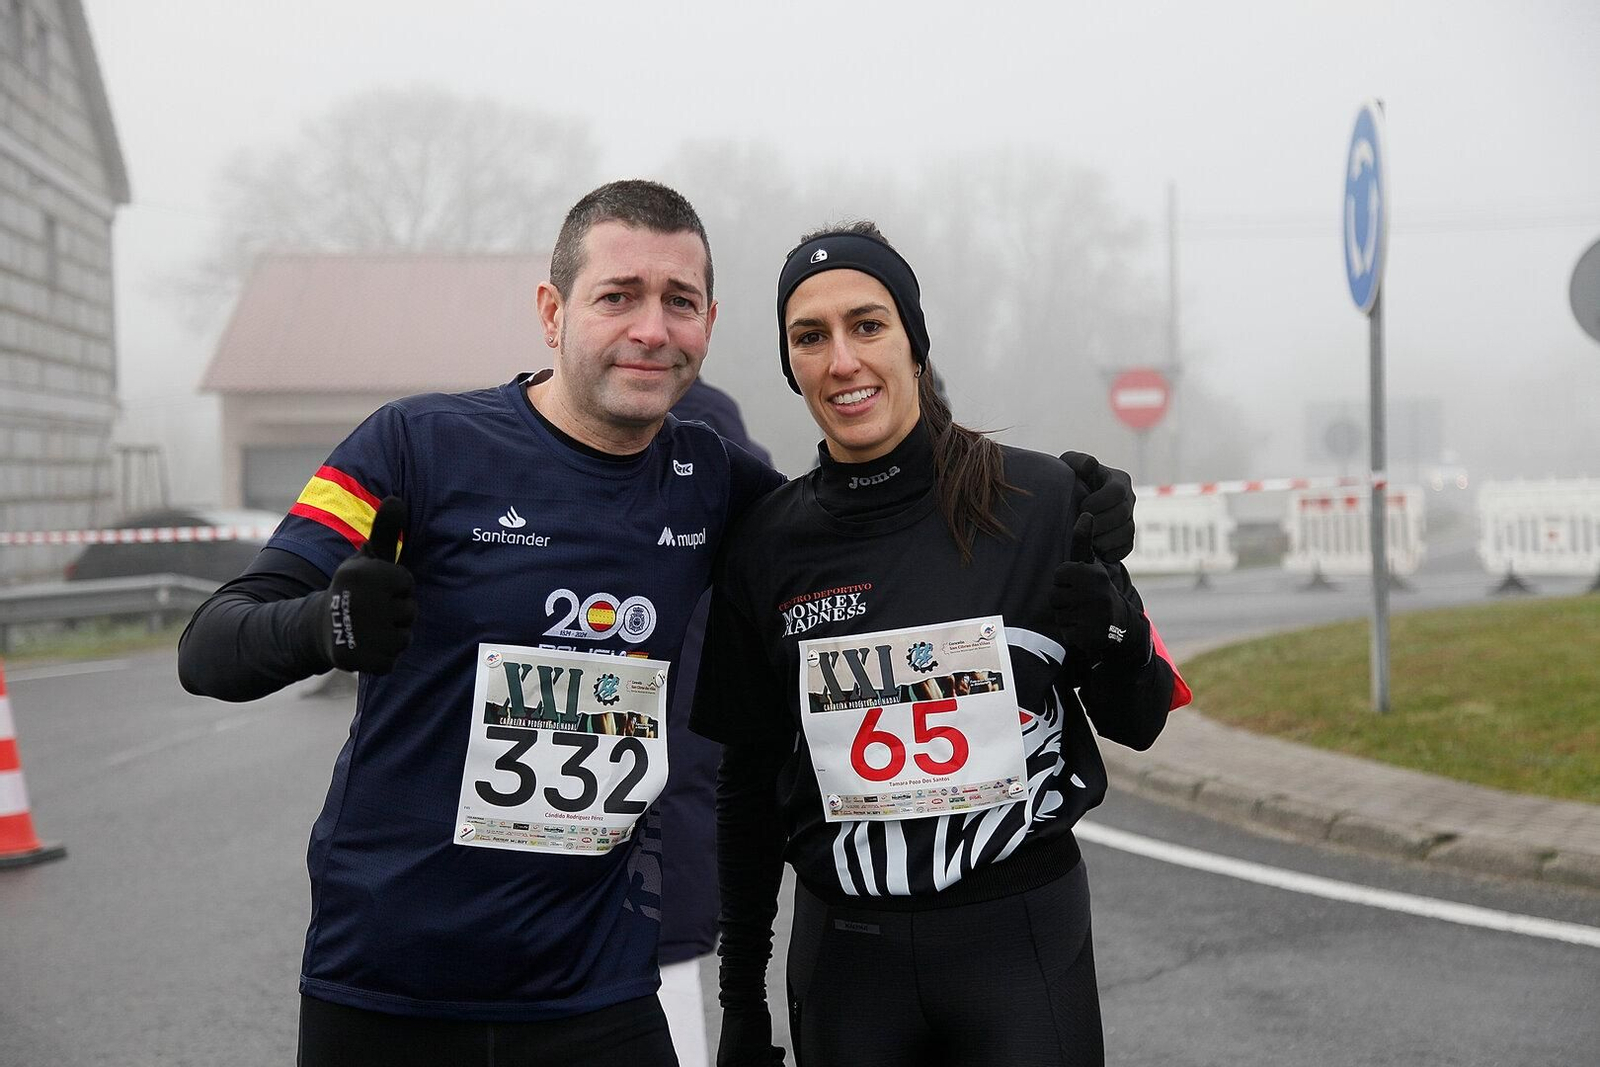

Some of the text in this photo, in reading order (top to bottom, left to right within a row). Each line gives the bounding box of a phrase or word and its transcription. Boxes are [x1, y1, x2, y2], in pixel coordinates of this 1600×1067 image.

[472, 528, 551, 547] Santander
[677, 527, 706, 550] mupol
[541, 588, 657, 644] 200
[779, 583, 872, 611] CENTRO DEPORTIVO
[782, 592, 861, 626] MONKEY
[330, 595, 346, 645] RUN
[782, 602, 867, 638] MADNESS
[498, 661, 584, 723] XXI
[818, 645, 900, 700] XXI
[851, 698, 969, 782] 65
[474, 726, 649, 814] 332
[889, 780, 908, 788] Tamara
[932, 776, 950, 784] Santos
